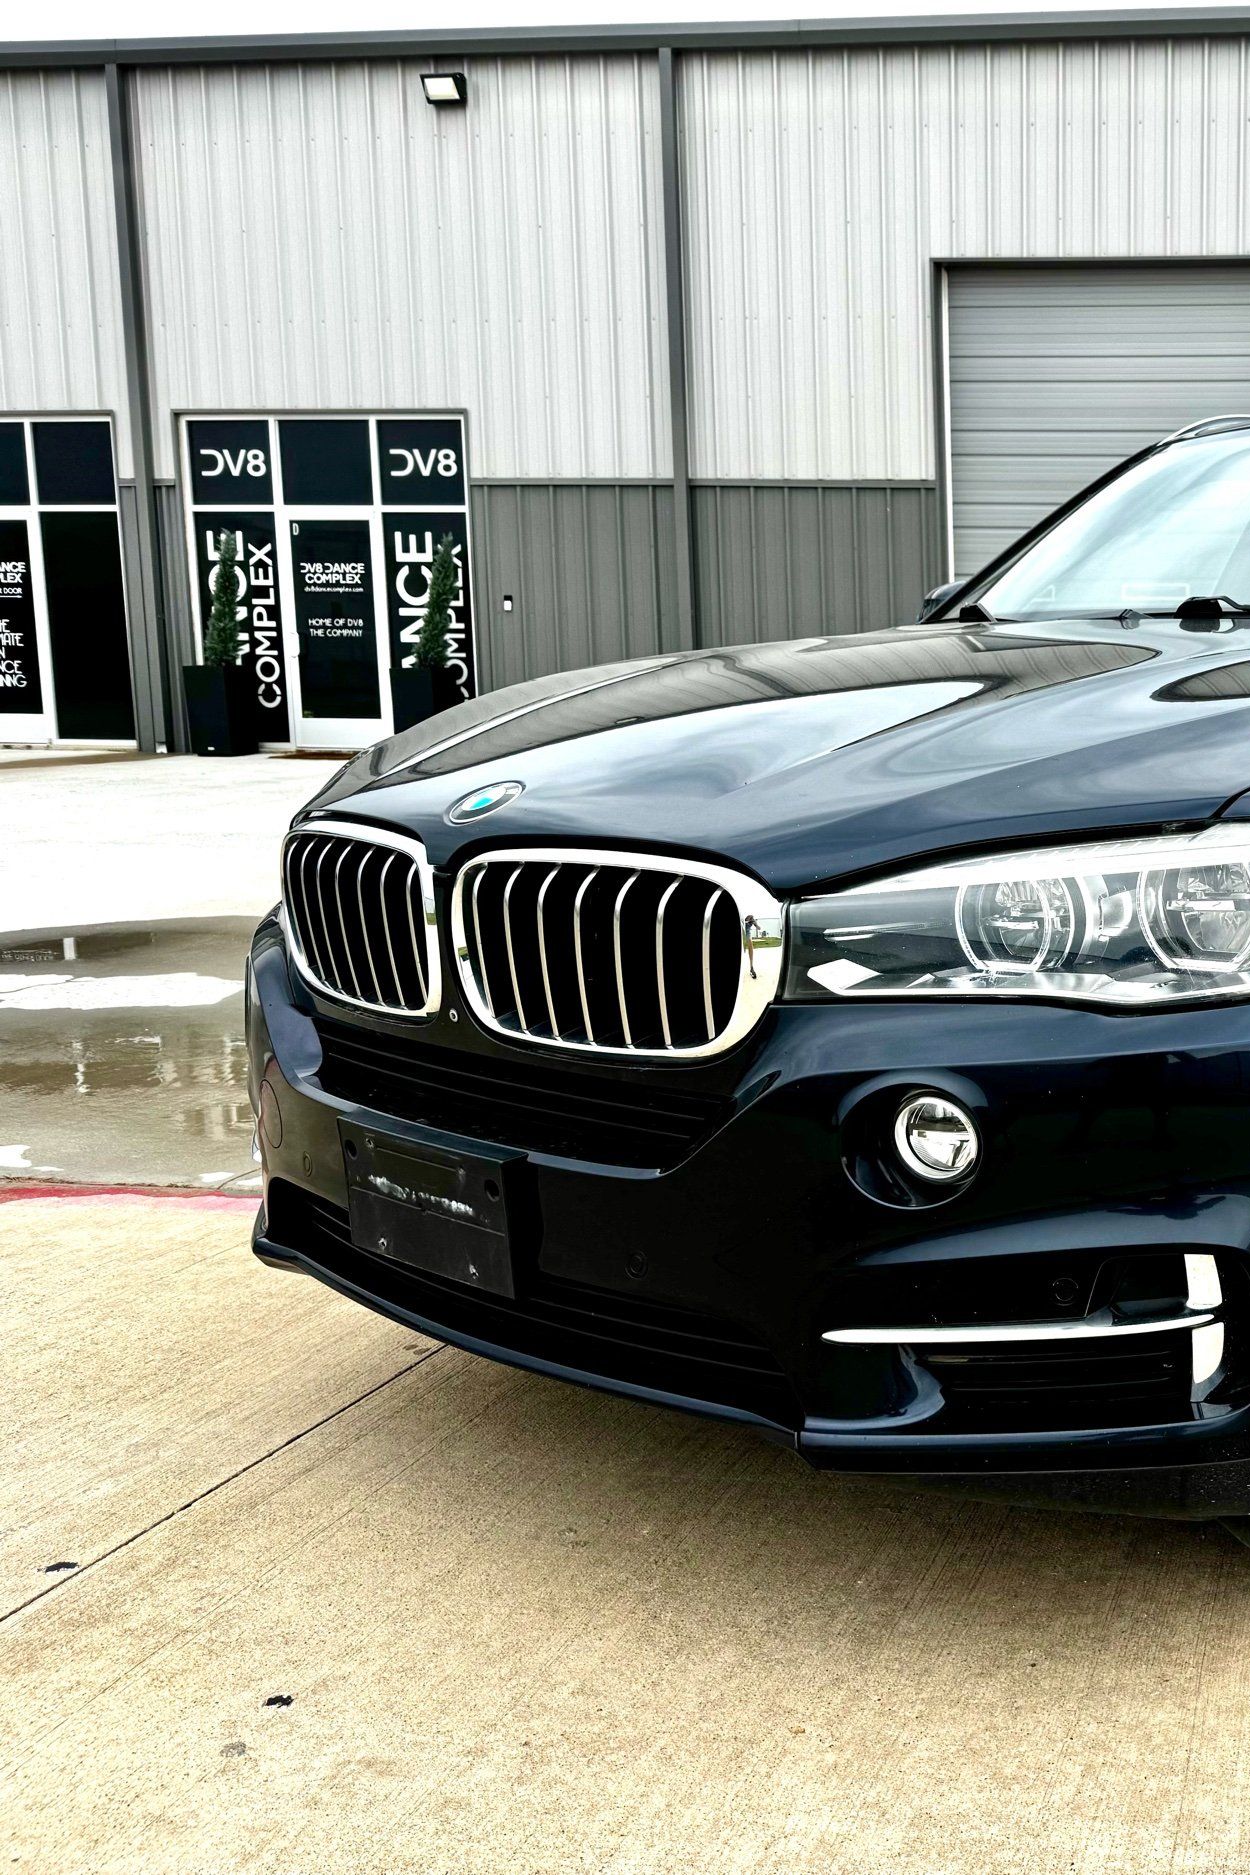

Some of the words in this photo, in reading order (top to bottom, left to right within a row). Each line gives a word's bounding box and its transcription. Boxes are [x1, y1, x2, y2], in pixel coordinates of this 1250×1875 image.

[200, 449, 267, 477] DV8
[389, 449, 458, 477] DV8
[300, 562, 323, 573] DV8
[324, 562, 365, 574] DANCE
[305, 573, 362, 584] COMPLEX
[248, 543, 282, 708] COMPLEX
[308, 618, 333, 627] HOME
[333, 618, 346, 627] OF
[347, 618, 364, 627] DV8
[310, 628, 325, 637] THE
[326, 628, 363, 637] COMPANY
